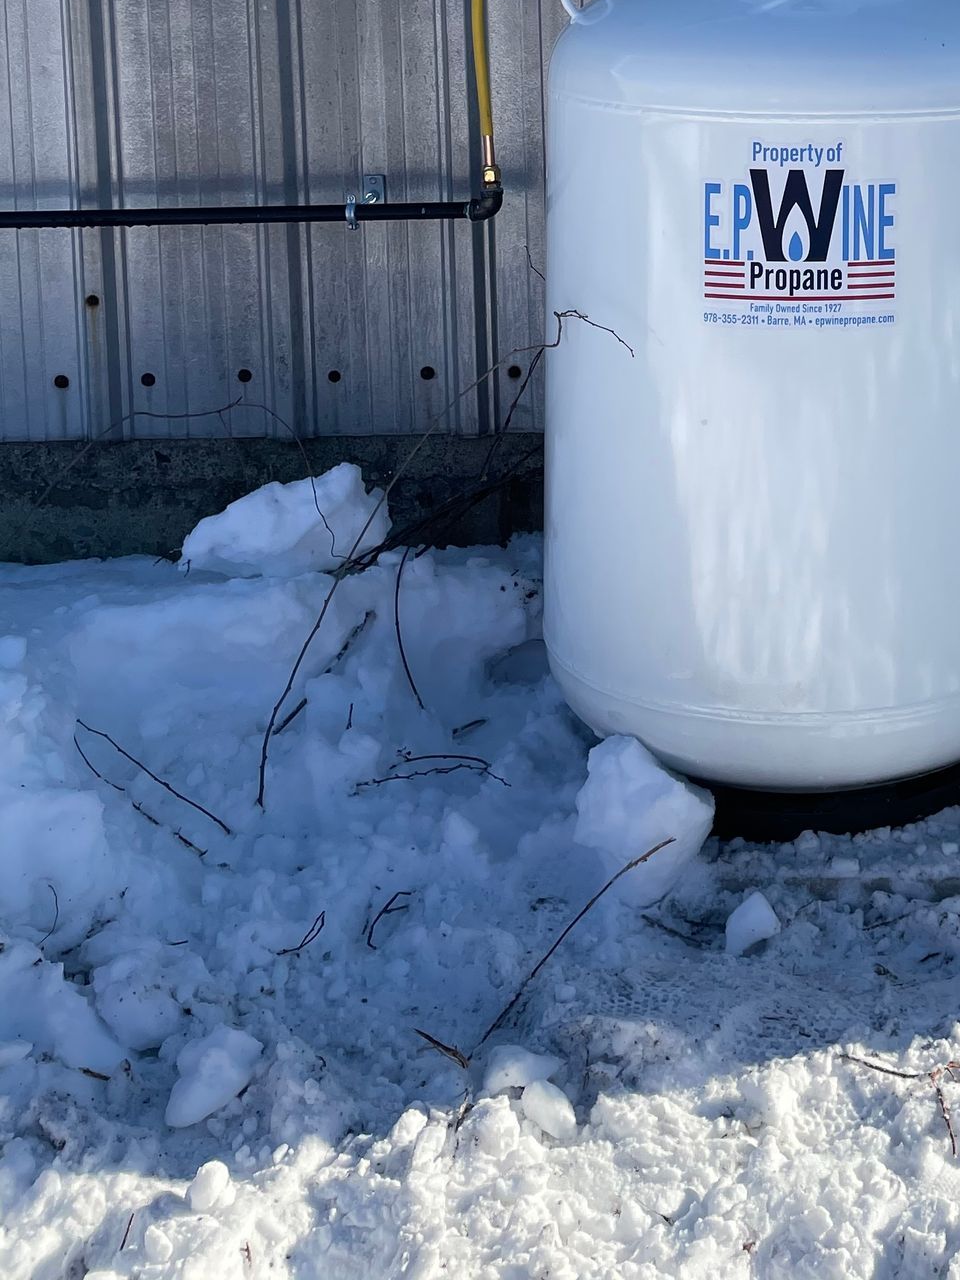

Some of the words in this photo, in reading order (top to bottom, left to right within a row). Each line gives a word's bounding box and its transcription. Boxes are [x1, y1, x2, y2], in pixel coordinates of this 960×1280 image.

[752, 141, 823, 167] Property
[826, 142, 843, 162] of
[704, 183, 754, 261] E.P.
[749, 169, 896, 262] WINE
[750, 262, 843, 296] Propane
[703, 313, 759, 325] 978-355-2311
[767, 317, 791, 327] Barre,
[794, 317, 806, 325] MA
[815, 314, 895, 327] epwinepropane.com
[750, 303, 774, 315] Family
[776, 304, 800, 313] Owned
[802, 304, 823, 313] Since
[824, 303, 842, 313] 1927
